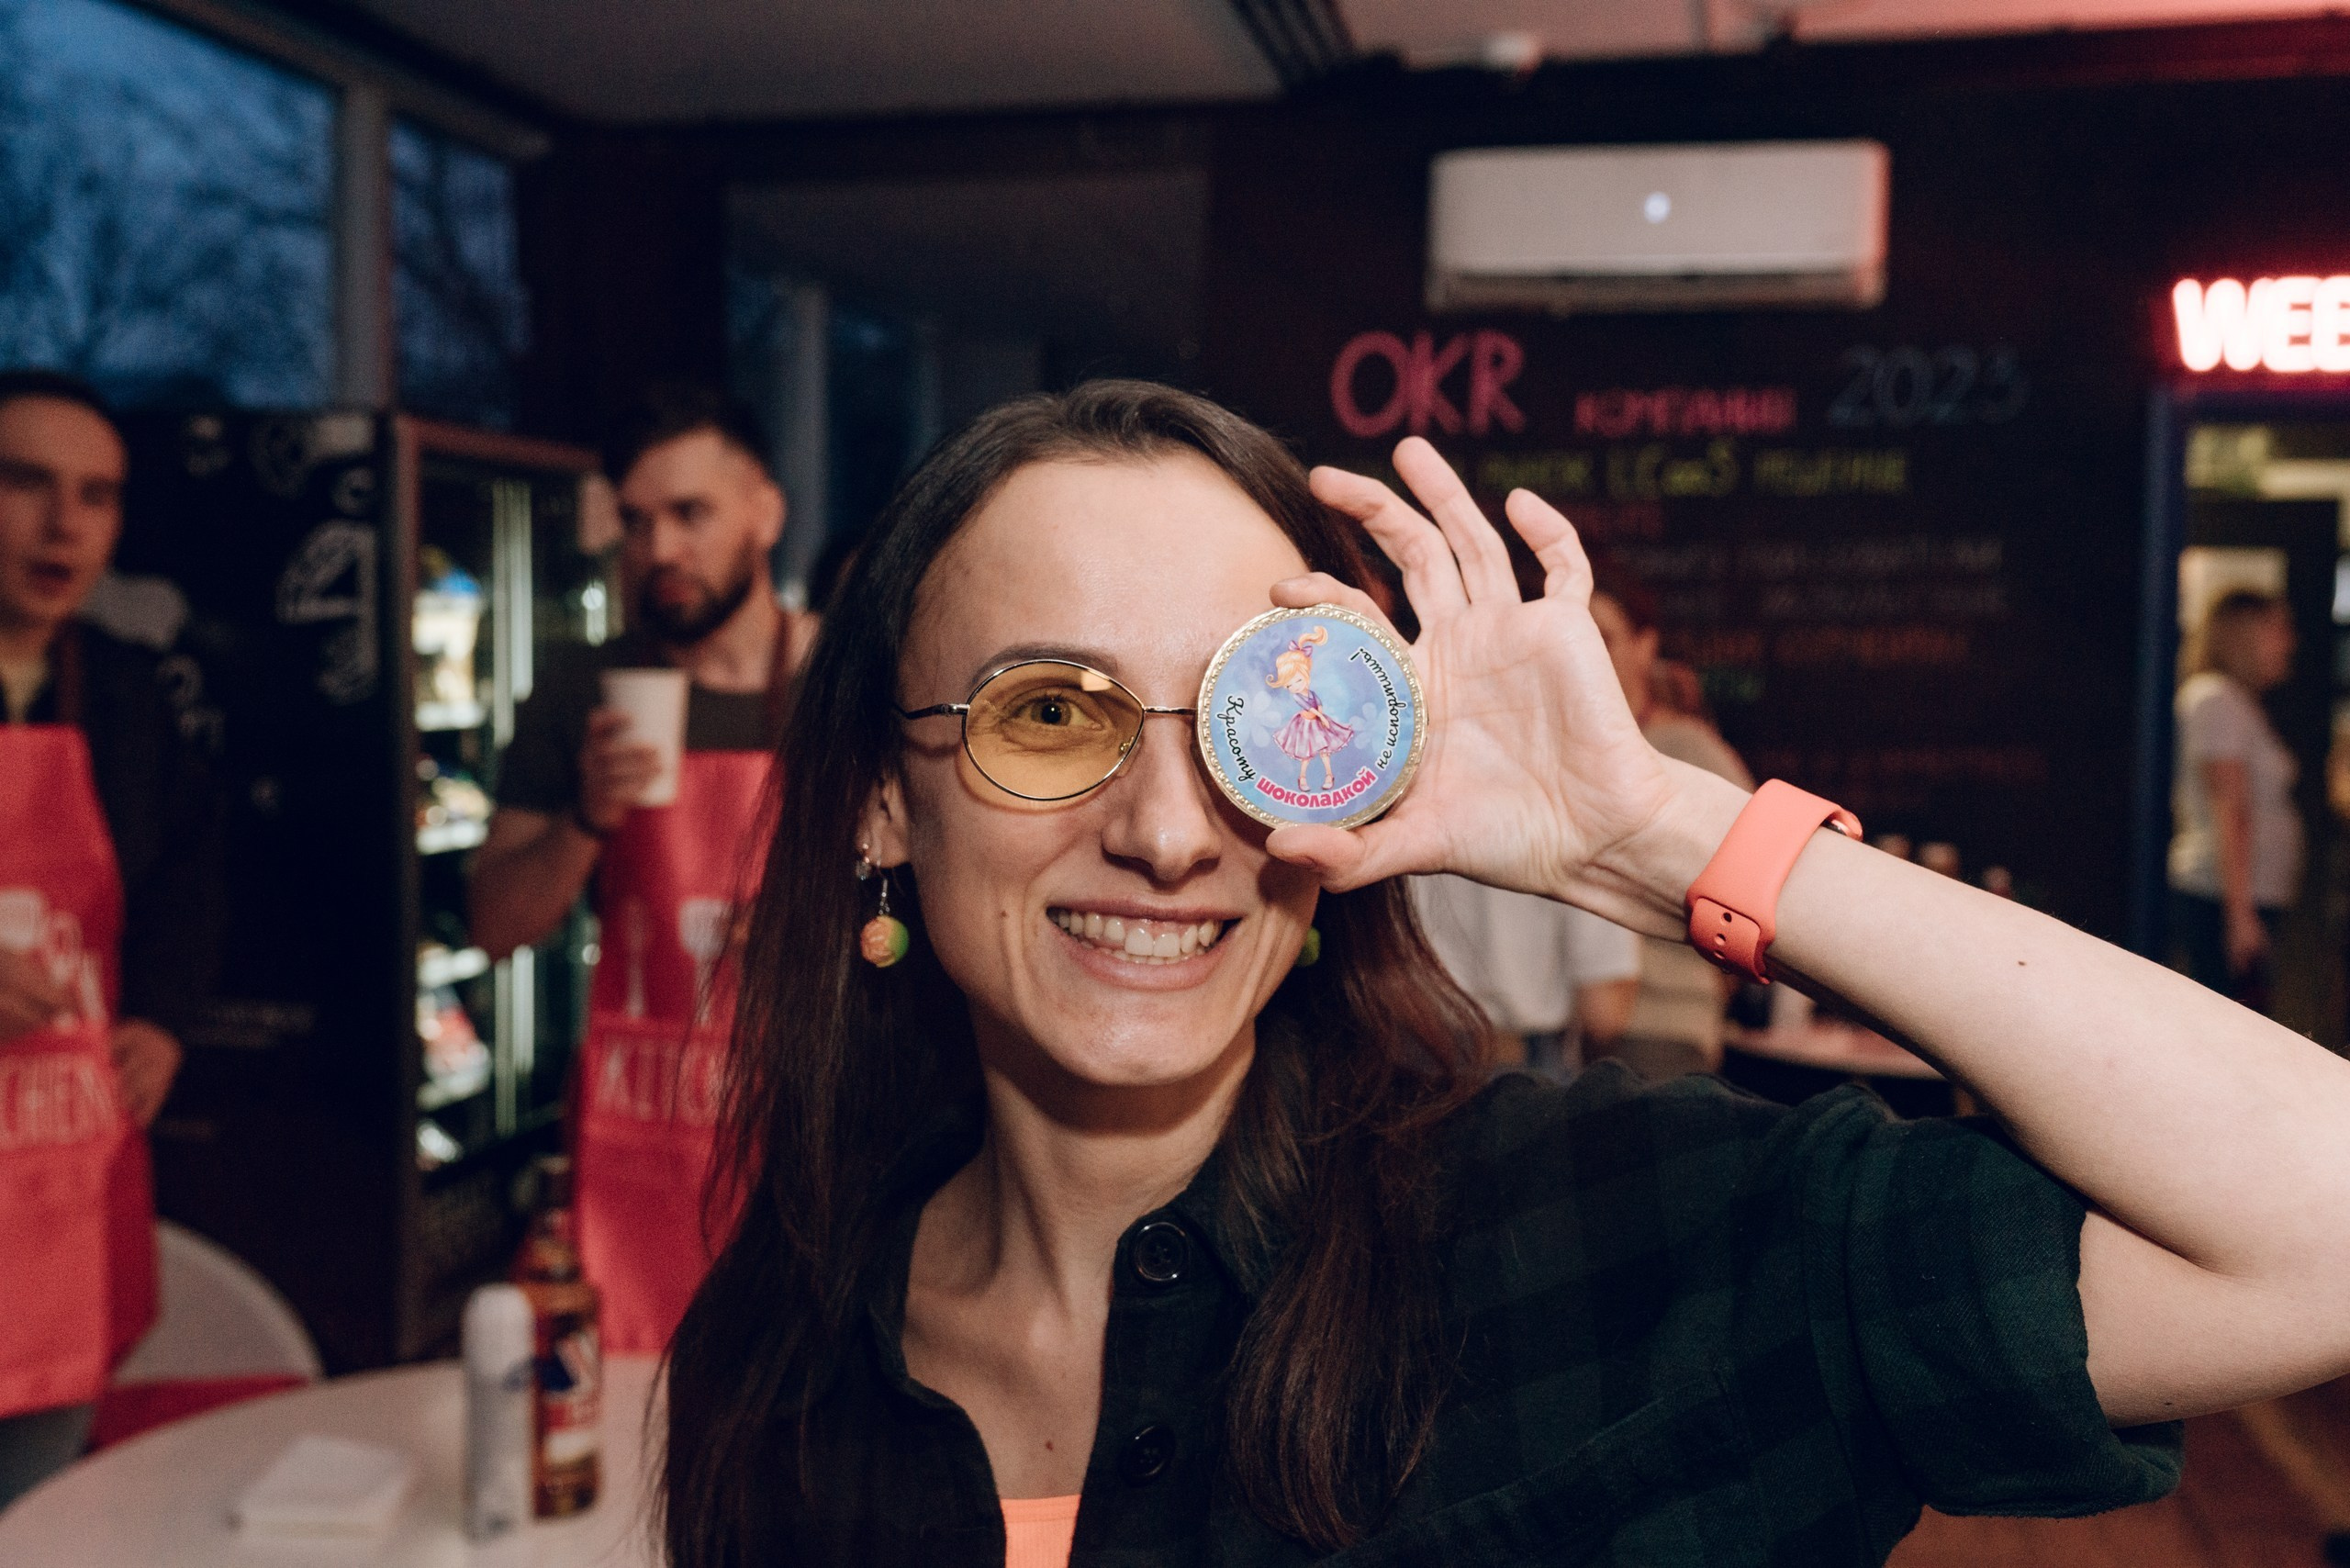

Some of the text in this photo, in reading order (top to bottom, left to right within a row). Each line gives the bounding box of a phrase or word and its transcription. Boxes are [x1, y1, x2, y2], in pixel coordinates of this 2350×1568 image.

[2172, 277, 2350, 372] WEE
[1331, 330, 1526, 438] OKR
[1217, 647, 1406, 808] Красоту шоколадкой не испортишь!
